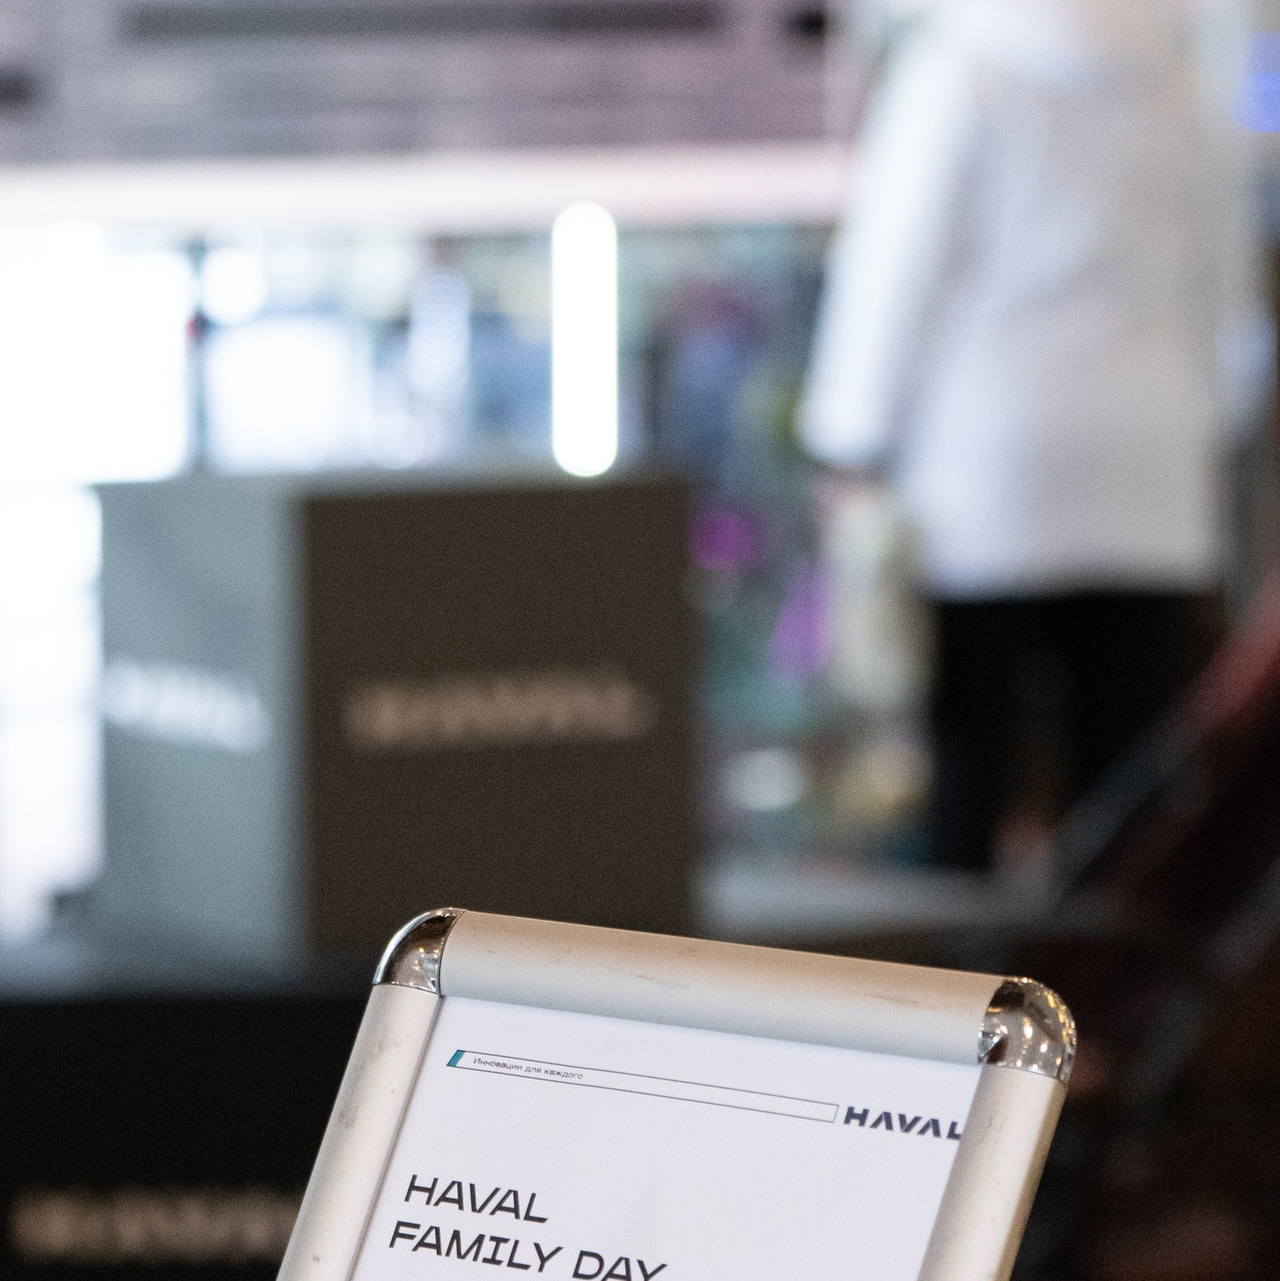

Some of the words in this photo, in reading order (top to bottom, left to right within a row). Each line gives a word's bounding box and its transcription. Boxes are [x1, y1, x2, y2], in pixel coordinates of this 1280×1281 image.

[473, 1057, 523, 1071] Инновации
[525, 1066, 542, 1074] для
[544, 1069, 583, 1080] каждого
[843, 1106, 962, 1140] HAVAL
[404, 1174, 548, 1223] HAVAL
[389, 1221, 563, 1273] FAMILY
